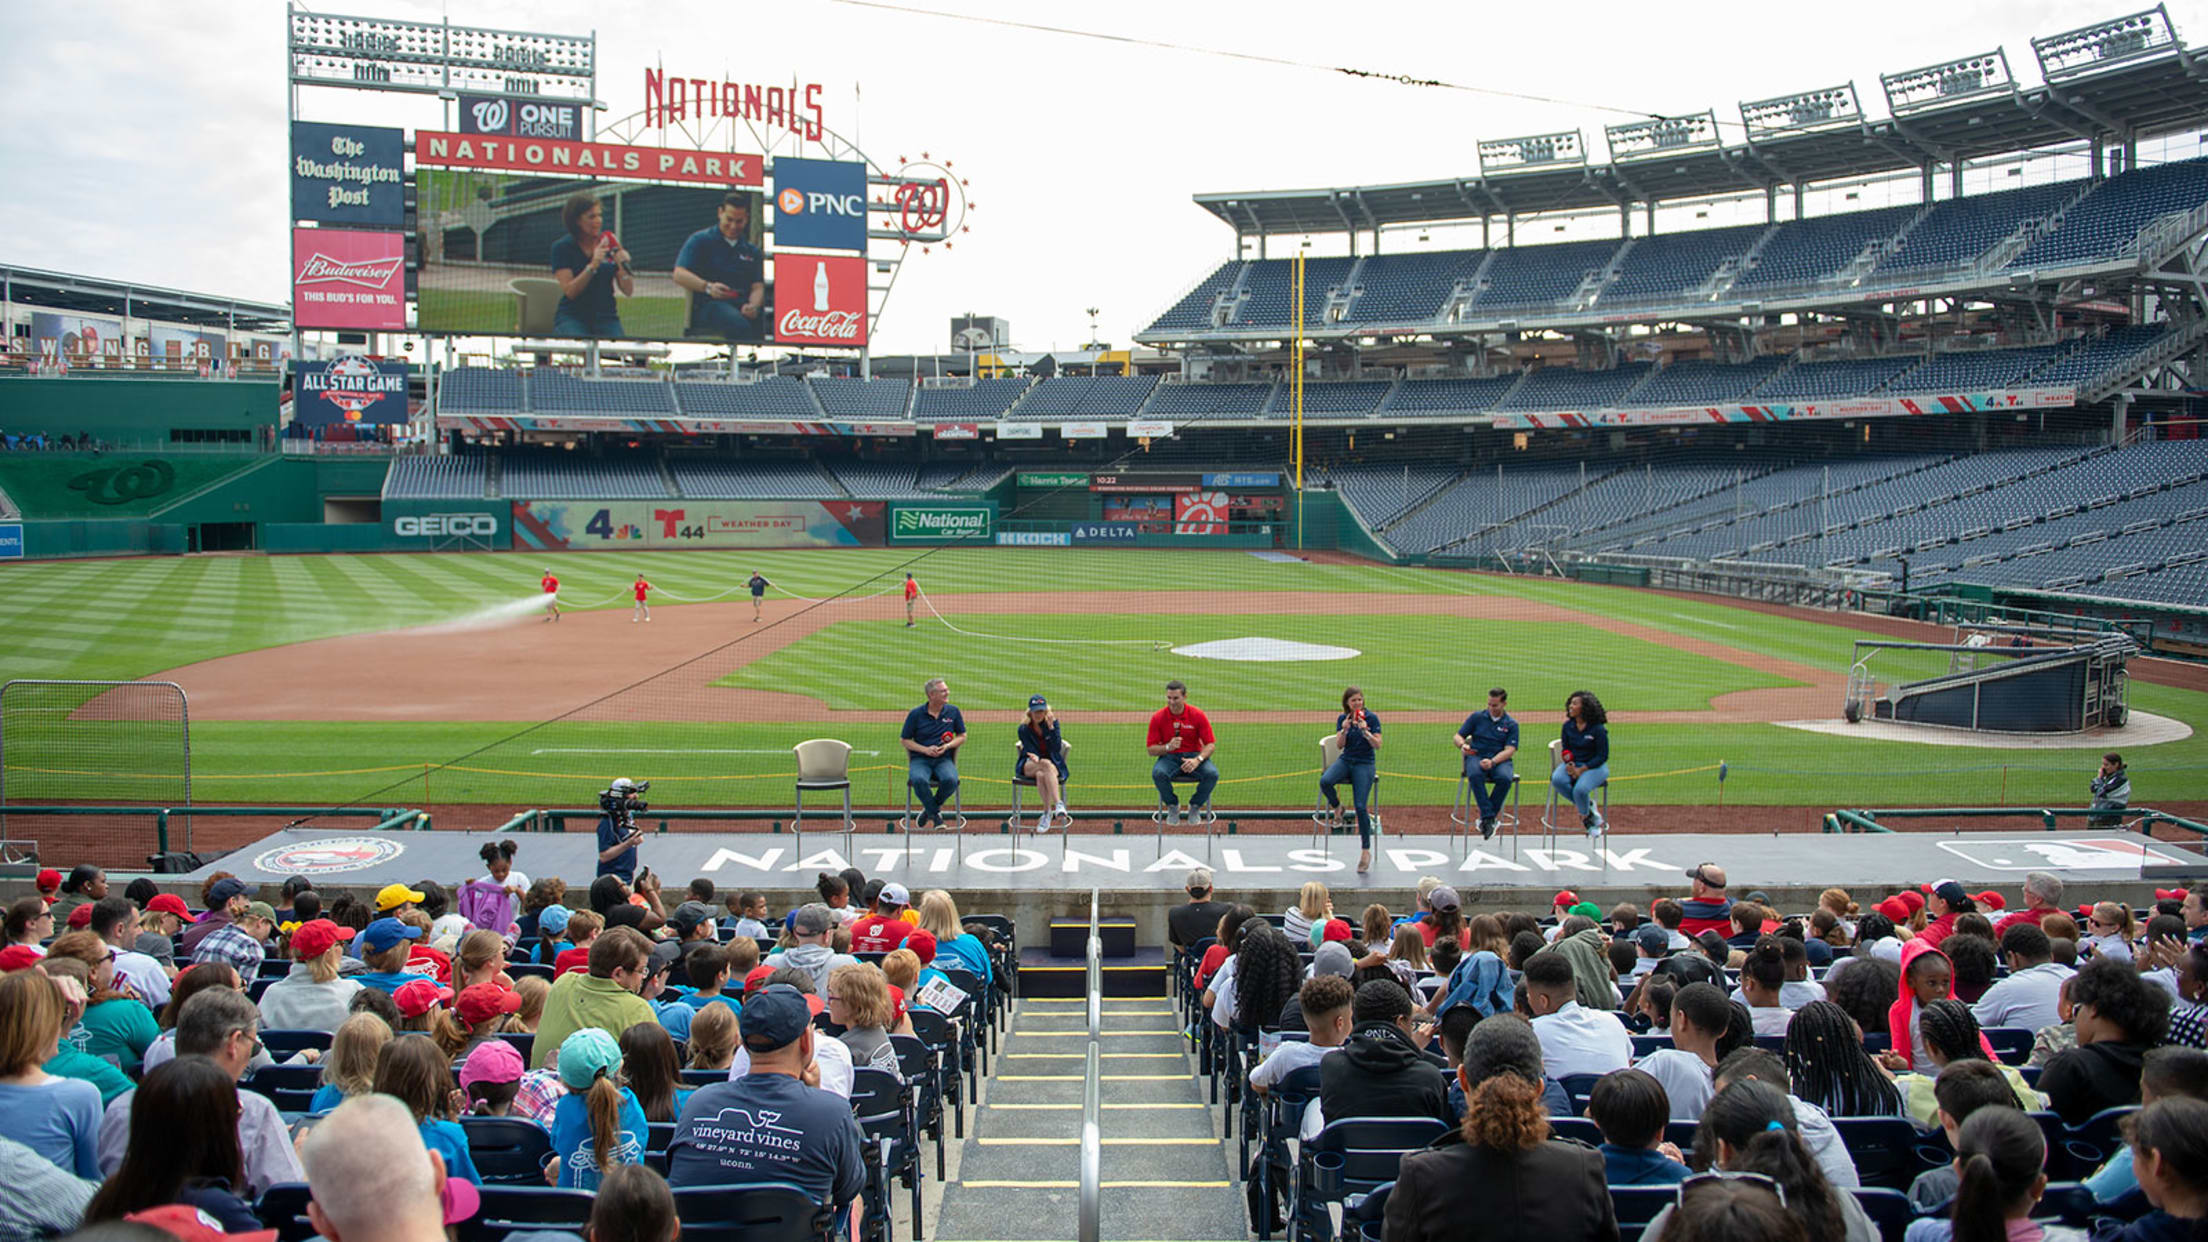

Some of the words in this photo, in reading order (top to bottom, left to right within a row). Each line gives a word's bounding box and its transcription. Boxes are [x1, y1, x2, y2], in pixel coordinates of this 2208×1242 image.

[520, 105, 574, 125] ONE
[645, 68, 823, 142] NATIONALS
[519, 120, 573, 139] PURSUIT
[331, 136, 365, 158] The
[428, 137, 641, 171] NATIONALS
[659, 152, 746, 179] PARK
[296, 155, 401, 185] Washington
[328, 185, 370, 208] Post
[807, 192, 863, 217] PNC
[304, 258, 392, 279] Budweiser
[303, 291, 325, 302] THIS
[326, 292, 354, 303] BUD'S
[356, 293, 375, 304] FOR
[375, 294, 398, 305] YOU.
[779, 308, 863, 339] Coca-Cola
[303, 374, 329, 391] ALL
[331, 375, 366, 391] STAR
[367, 375, 403, 392] GAME
[394, 516, 498, 537] GEICO
[585, 509, 614, 540] 4
[680, 525, 705, 539] 44
[721, 520, 770, 529] WEATHER
[772, 520, 792, 528] DAY
[1089, 526, 1134, 538] DELTA
[1017, 533, 1065, 545] KOCH
[701, 847, 1346, 873] NATIONALS
[1385, 847, 1684, 873] PARK
[692, 1123, 755, 1143] vineyard
[757, 1131, 801, 1152] vines
[719, 1158, 755, 1170] uconn.
